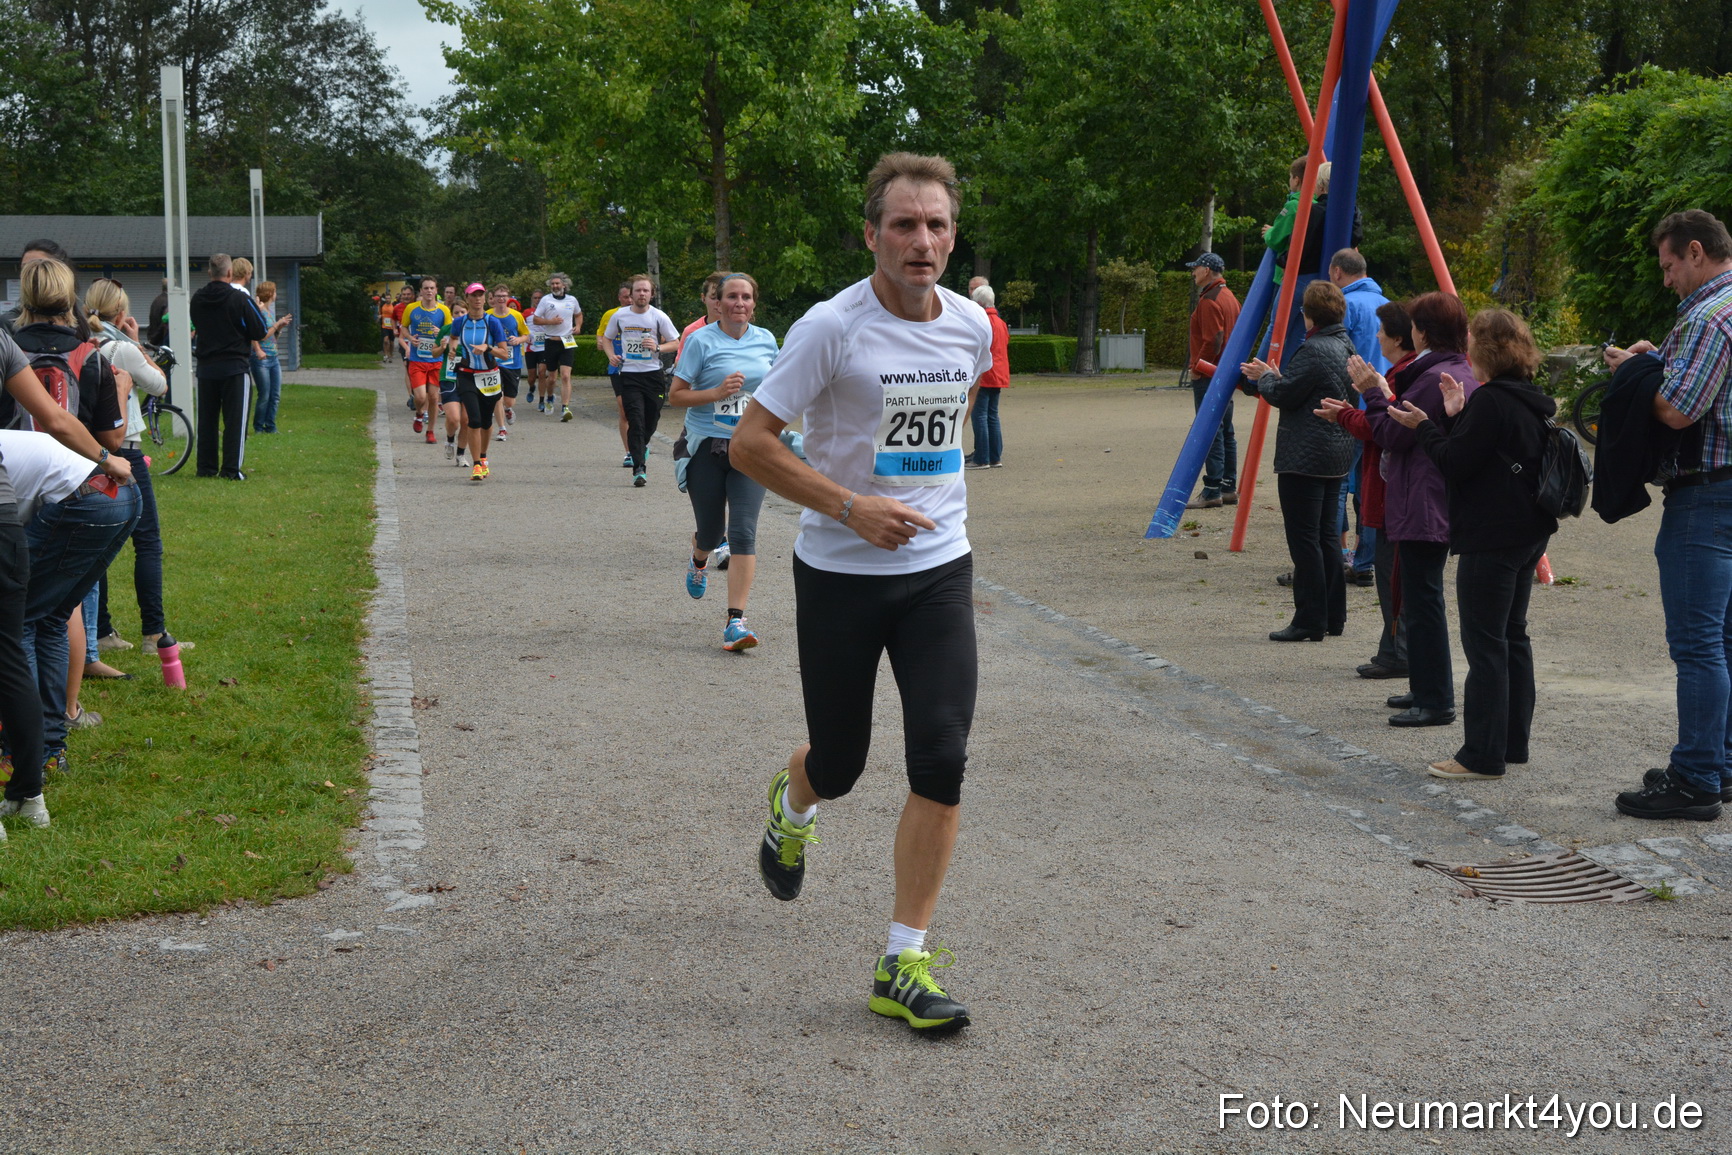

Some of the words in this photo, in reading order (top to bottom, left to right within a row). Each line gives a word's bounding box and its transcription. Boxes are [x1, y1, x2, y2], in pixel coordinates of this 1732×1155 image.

[481, 375, 498, 387] 125
[880, 369, 968, 384] www.hasit.de
[885, 397, 916, 407] PARTL
[918, 396, 958, 406] Neumarkt
[885, 408, 959, 447] 2561
[902, 457, 943, 472] Hubert
